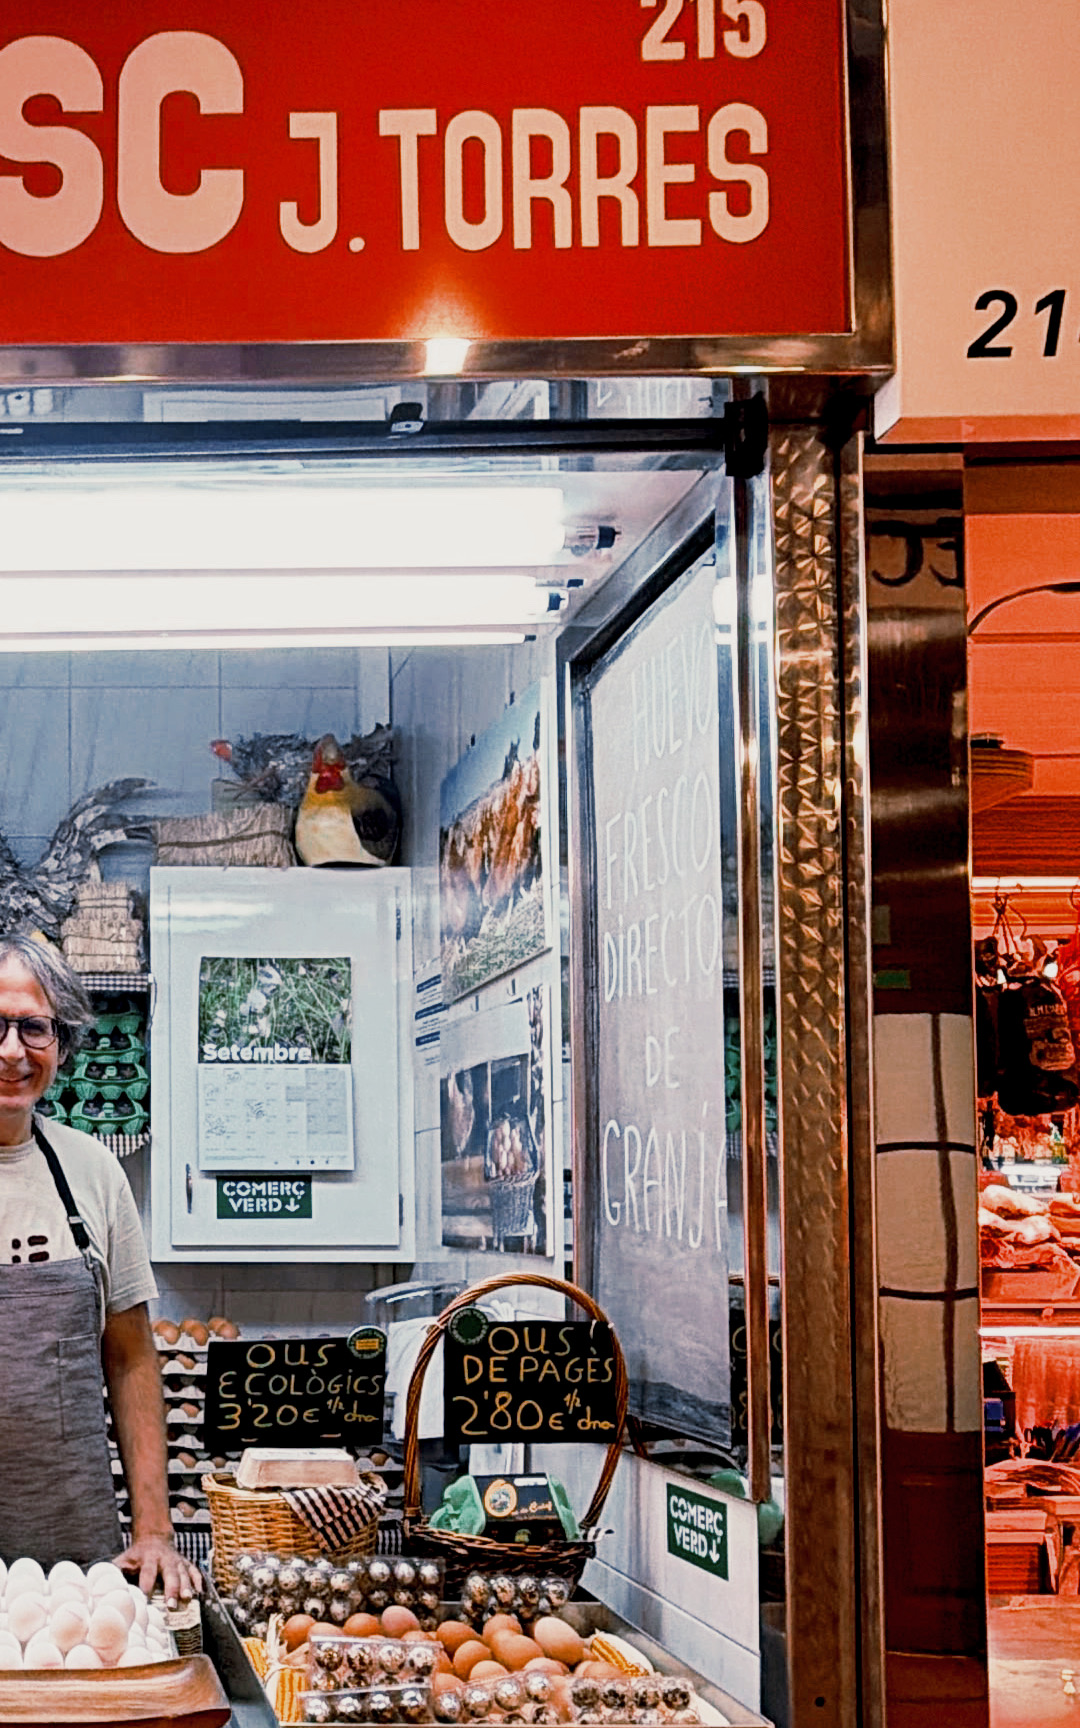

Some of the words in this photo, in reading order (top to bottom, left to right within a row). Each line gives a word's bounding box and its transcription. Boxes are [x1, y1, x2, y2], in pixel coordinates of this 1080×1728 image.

[640, 0, 768, 61] 215
[279, 111, 366, 254] J.
[379, 102, 771, 252] TORRES
[967, 289, 1080, 358] 21
[604, 770, 715, 910] FRESCO
[604, 894, 719, 1002] DIRECTO
[203, 1043, 312, 1062] Setembre
[645, 1026, 681, 1089] DE
[222, 1181, 306, 1199] COMERÇ
[228, 1198, 282, 1213] VERD
[246, 1343, 337, 1368] OUS
[487, 1326, 575, 1356] OUS
[219, 1368, 383, 1398] ECOLÒGICS
[463, 1354, 508, 1385] DE
[519, 1346, 614, 1384] PAGÈS
[670, 1495, 724, 1544] COMERÇ
[673, 1522, 708, 1558] VERD
